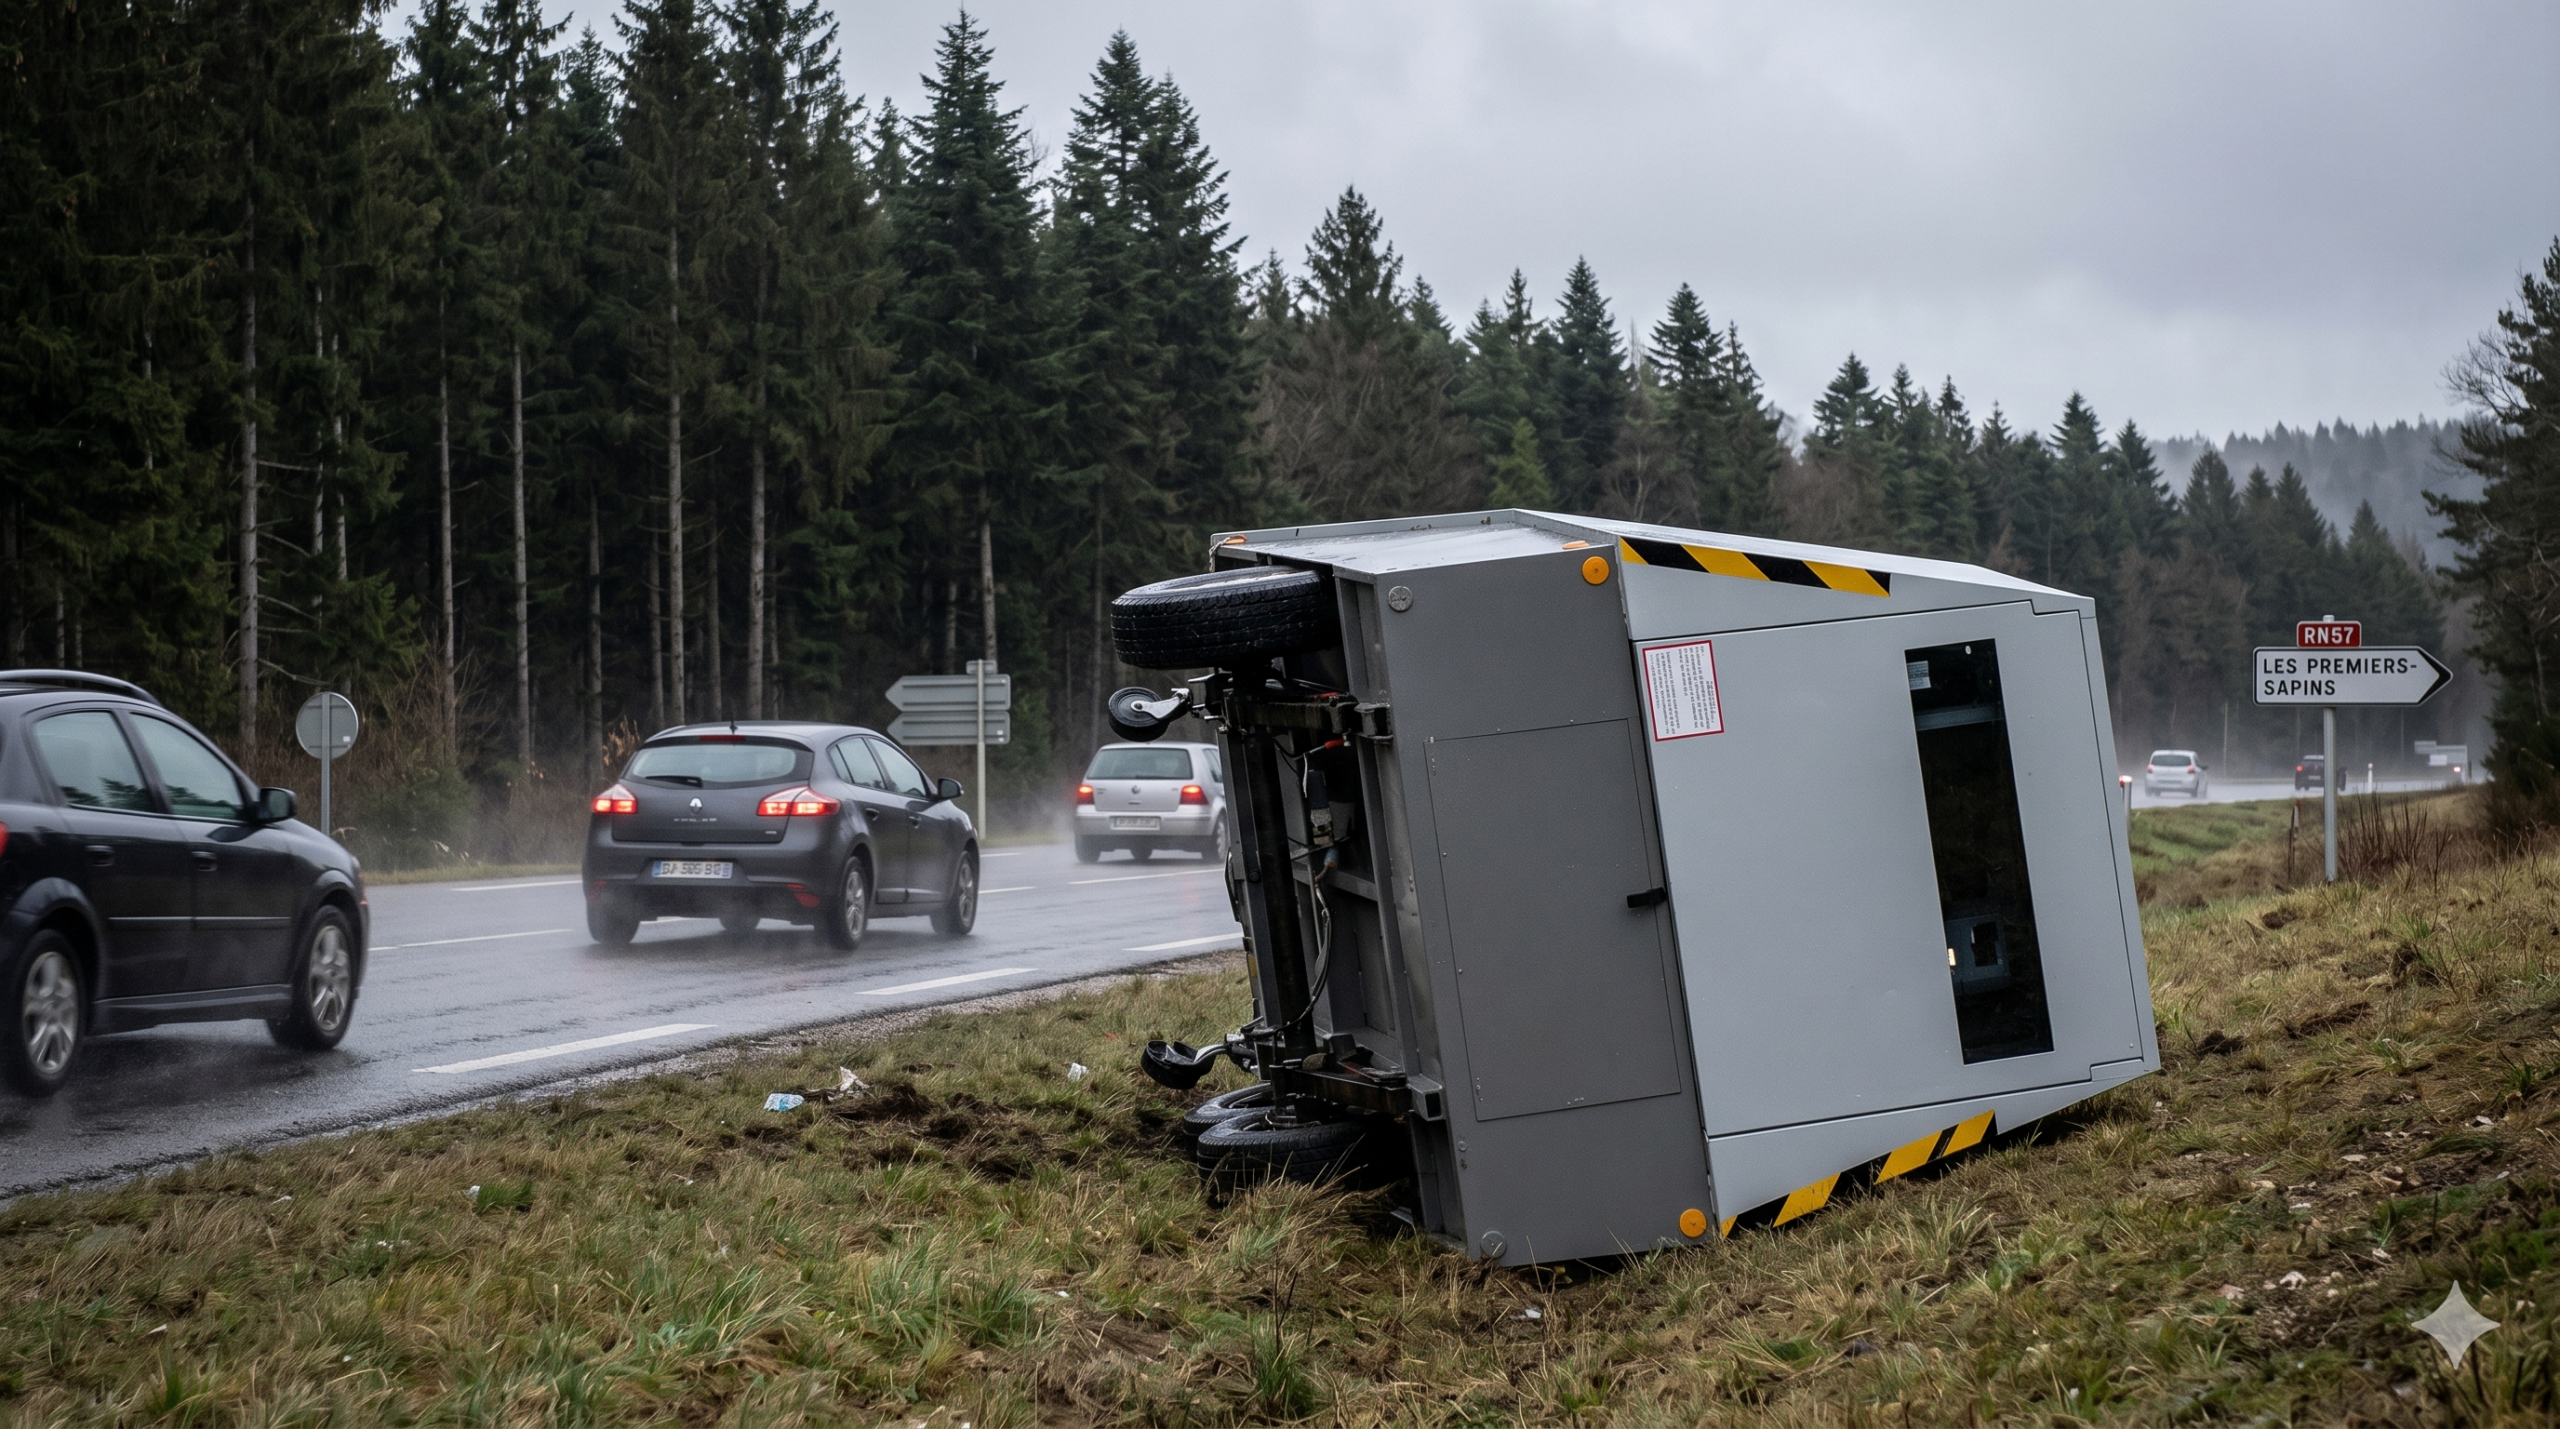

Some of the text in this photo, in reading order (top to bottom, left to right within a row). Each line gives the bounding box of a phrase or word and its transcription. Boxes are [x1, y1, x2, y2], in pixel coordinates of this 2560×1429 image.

[2304, 627, 2354, 644] RN57
[2263, 658, 2417, 674] LES PREMIERS-
[2264, 680, 2336, 696] SAPINS
